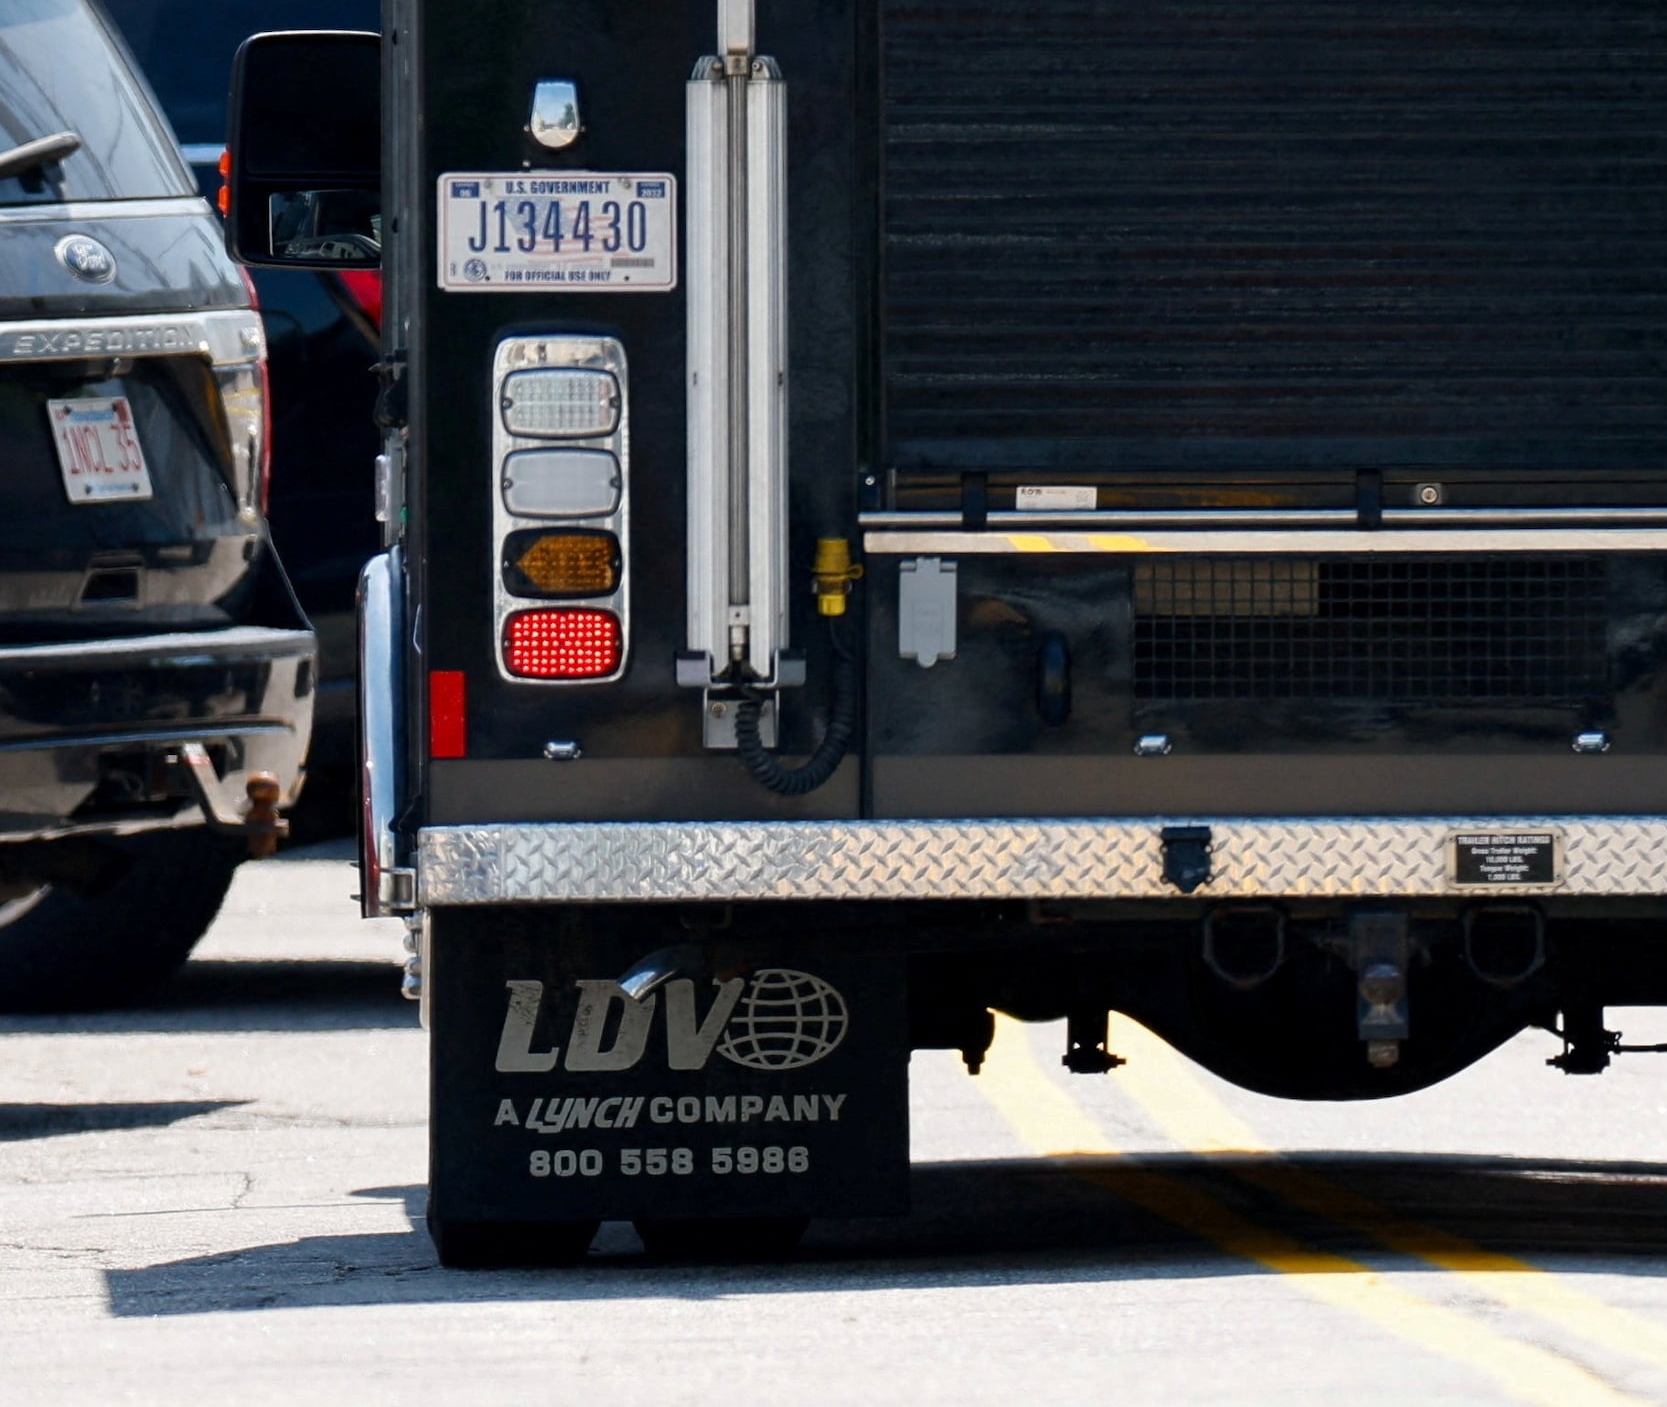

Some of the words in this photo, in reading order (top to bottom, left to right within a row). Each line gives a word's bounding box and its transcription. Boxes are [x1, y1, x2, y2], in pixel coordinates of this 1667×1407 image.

[505, 181, 528, 195] U.S.
[530, 181, 610, 195] GOVERNMENT
[468, 200, 647, 253] J134430
[504, 270, 523, 282] FOR
[525, 270, 566, 282] OFFICIAL
[568, 270, 586, 282] USE
[588, 270, 611, 282] ONLY
[1458, 836, 1490, 845] TRAILER
[1517, 835, 1551, 844] RATINGS
[495, 978, 745, 1072] LDV
[494, 1098, 520, 1126] A
[524, 1096, 646, 1134] LYNCH
[649, 1093, 849, 1125] COMPANY
[528, 1149, 603, 1178] 800
[619, 1148, 695, 1176] 558
[710, 1146, 810, 1175] 5986
